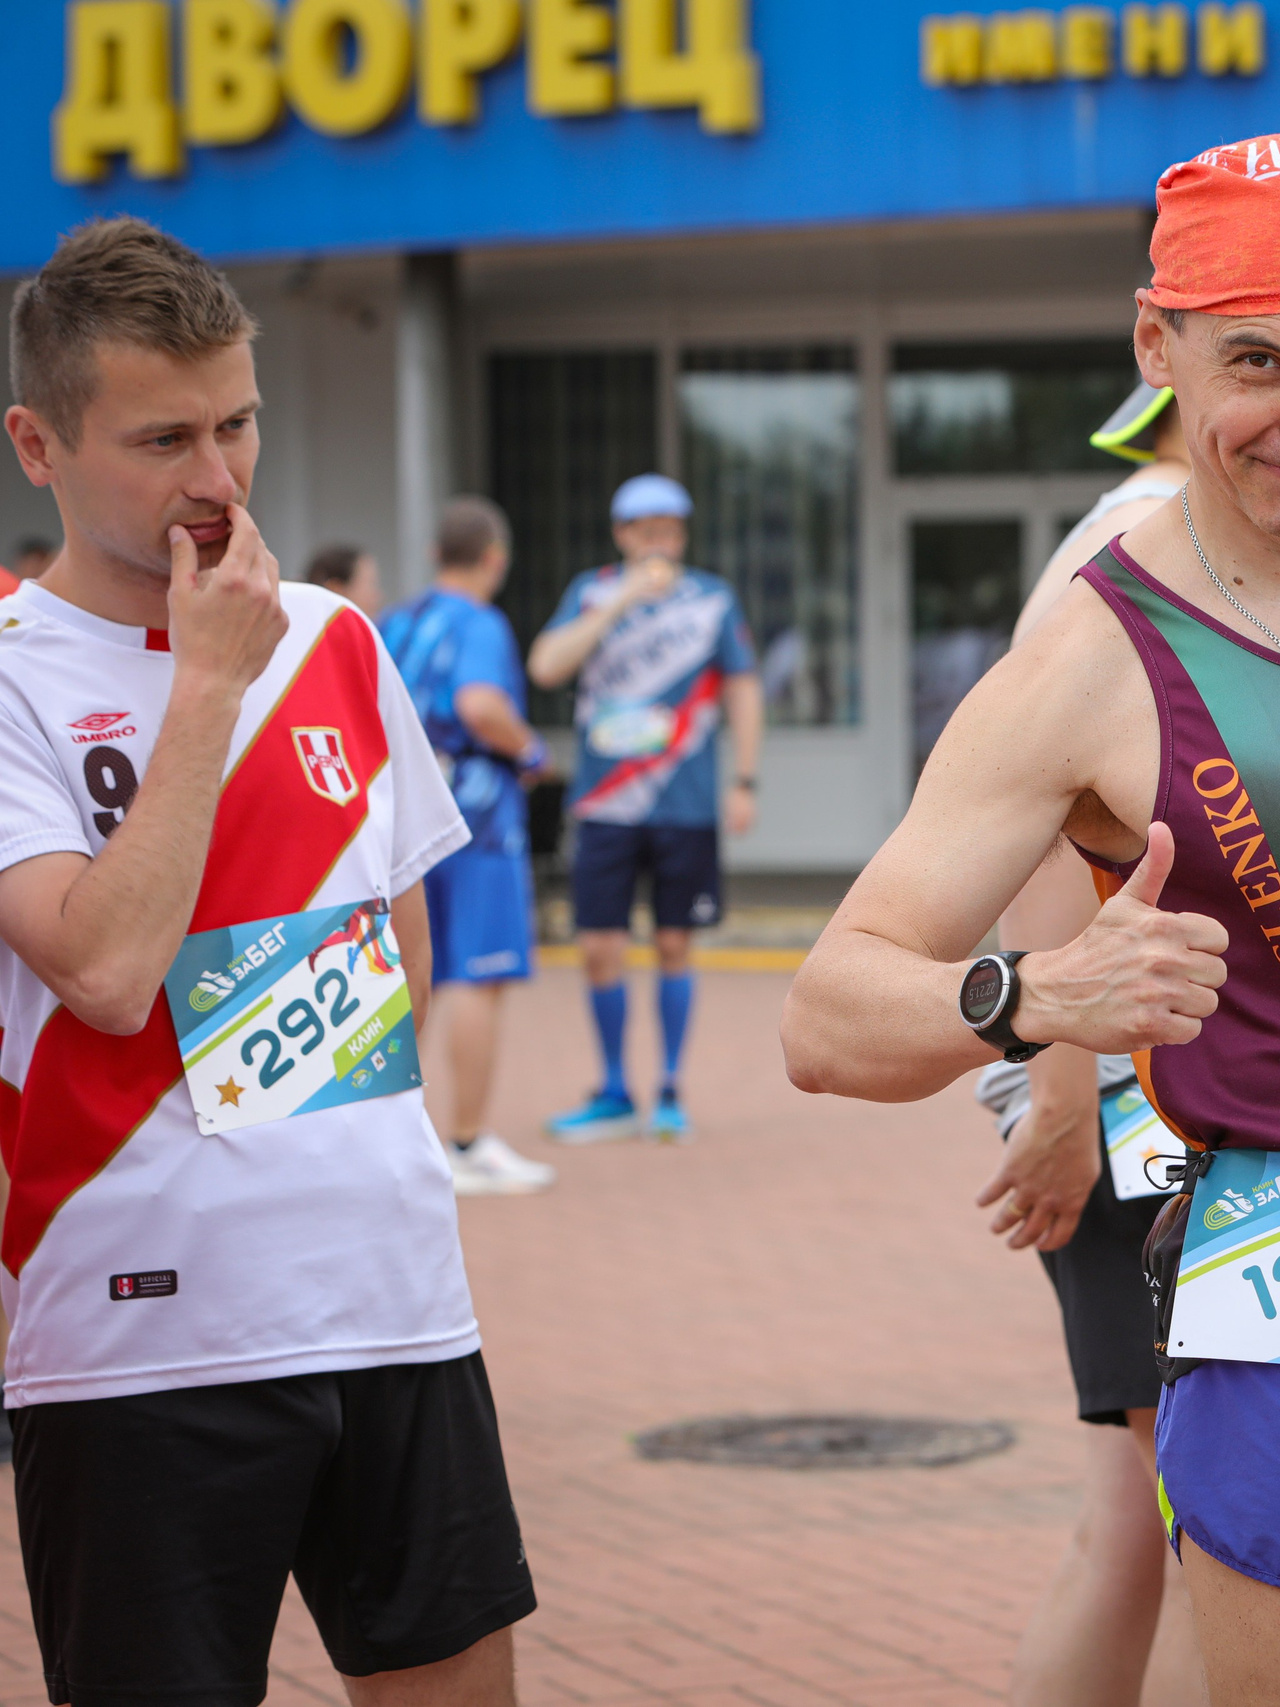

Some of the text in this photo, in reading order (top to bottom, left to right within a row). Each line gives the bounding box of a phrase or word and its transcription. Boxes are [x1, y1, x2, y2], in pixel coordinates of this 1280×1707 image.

[52, 0, 762, 184] ДВОРЕЦ
[71, 726, 137, 744] UMBRO
[241, 968, 360, 1090] 292
[347, 1017, 385, 1058] КЛИН
[1252, 1179, 1274, 1193] КЛИН
